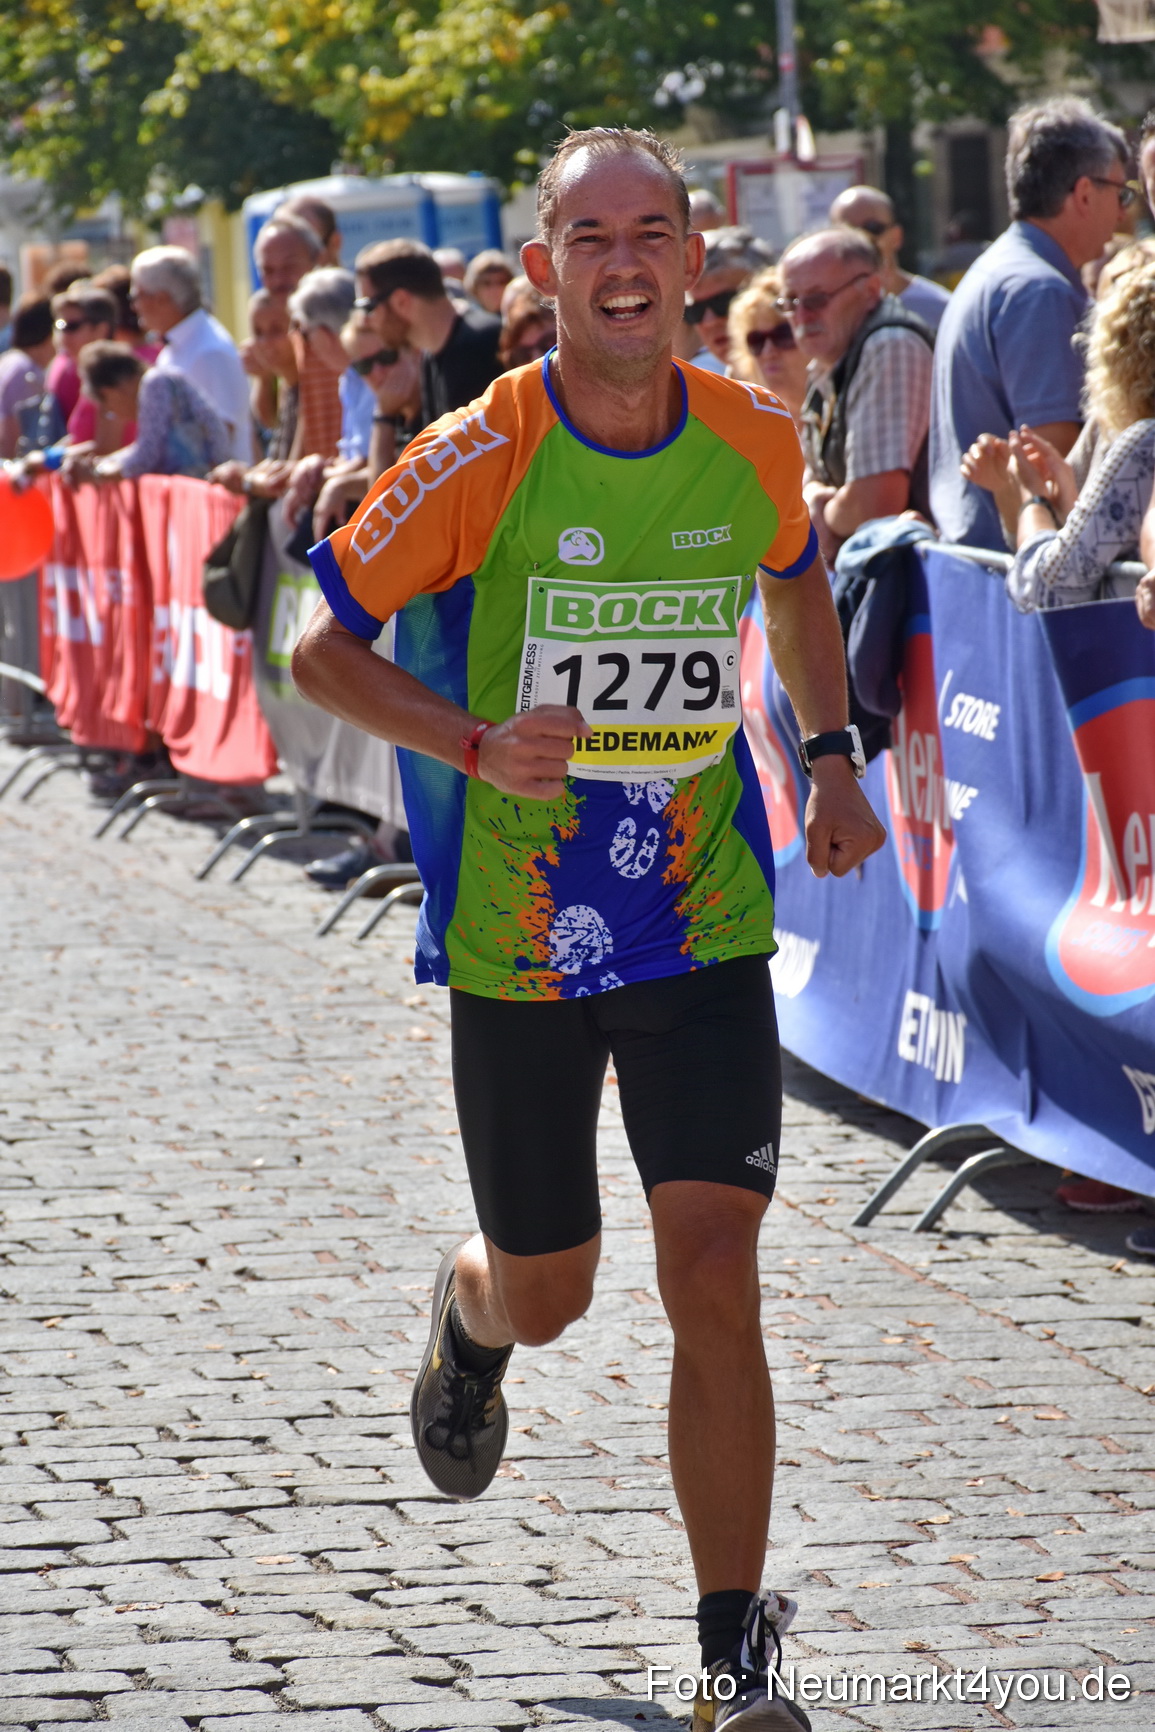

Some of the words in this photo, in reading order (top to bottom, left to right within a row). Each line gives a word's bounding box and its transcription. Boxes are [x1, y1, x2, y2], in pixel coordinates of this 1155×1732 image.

[350, 409, 511, 564] BOCK
[671, 523, 732, 550] BOCK
[545, 587, 730, 636] BOCK
[553, 650, 721, 712] 1279
[574, 729, 718, 752] IEDEMANN
[944, 692, 1001, 742] STORE
[745, 1155, 777, 1176] adidas
